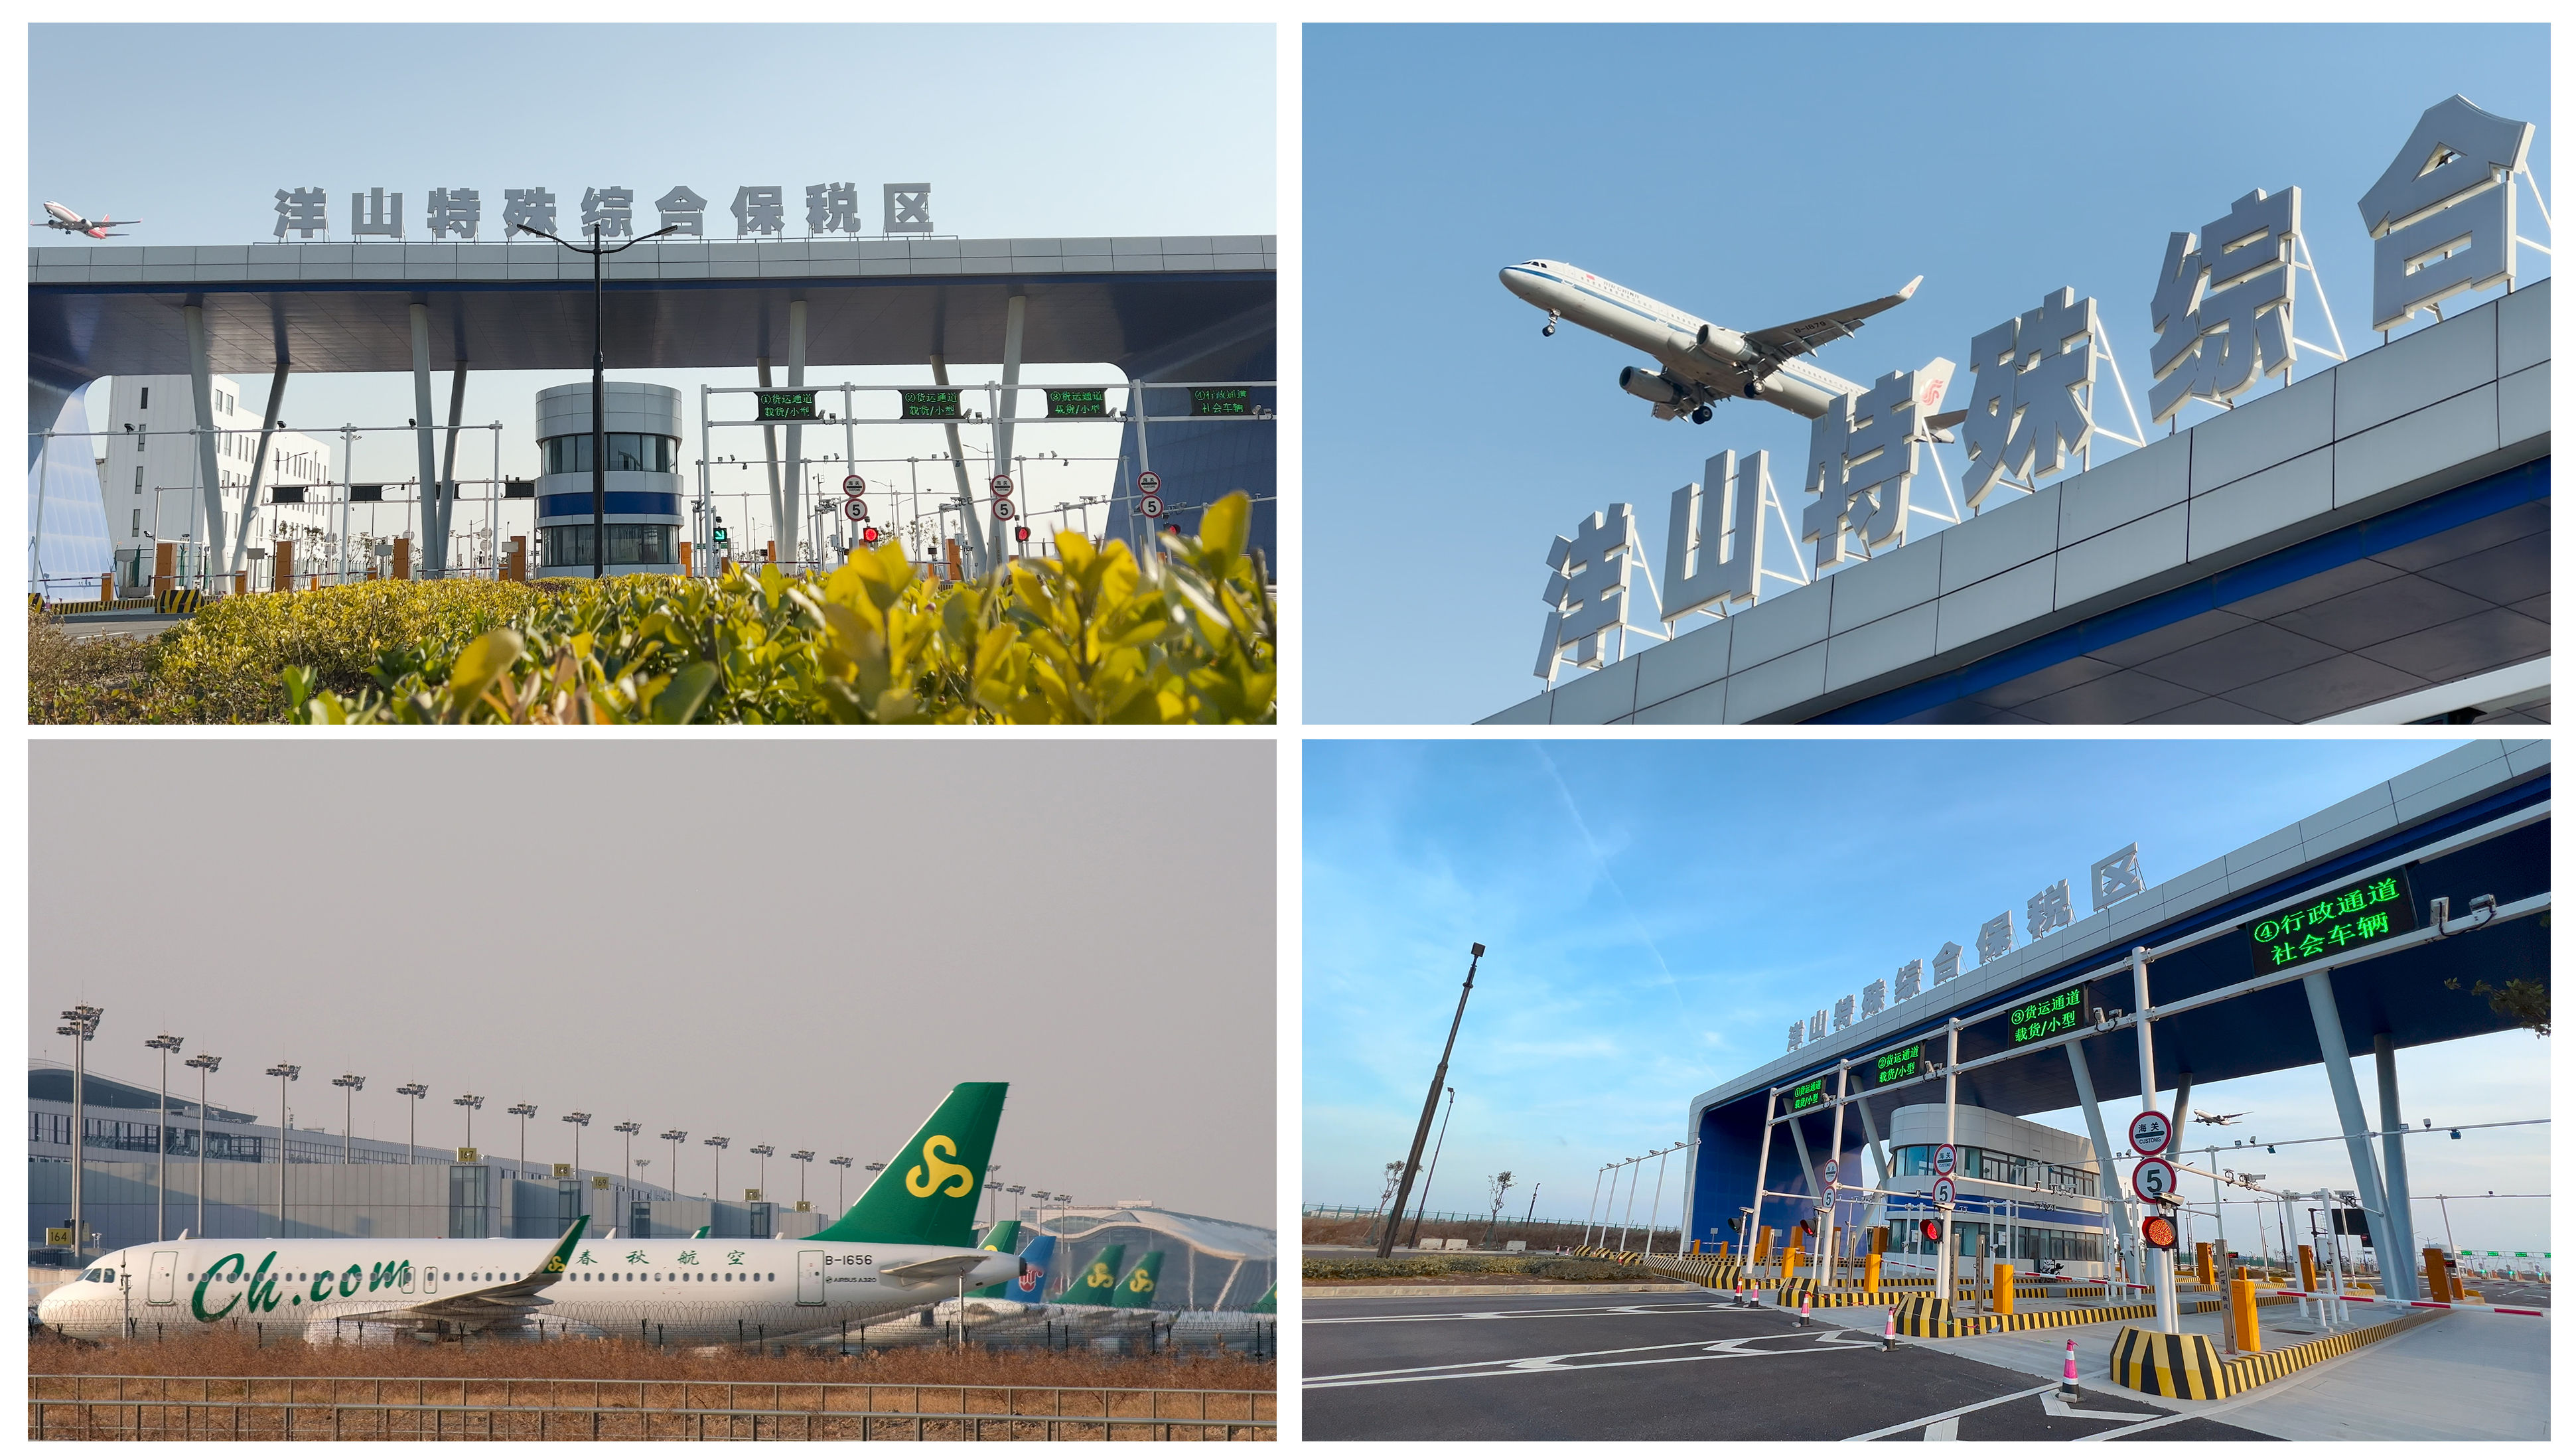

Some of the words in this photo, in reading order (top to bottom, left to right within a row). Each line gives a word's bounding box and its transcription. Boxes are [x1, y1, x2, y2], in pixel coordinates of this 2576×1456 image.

[273, 182, 934, 239] 洋山特殊综合保税区
[1794, 321, 1827, 333] B-1879
[1534, 94, 2535, 682] 洋山特殊综合
[852, 504, 861, 516] 5
[1000, 504, 1009, 516] 5
[1148, 501, 1157, 512] 5
[2254, 878, 2400, 942] ④行政通道
[1787, 841, 2143, 1052] 洋山特殊综合保税区
[2271, 912, 2389, 965] 社会车辆
[2011, 989, 2081, 1025] ③货运通道
[2015, 1011, 2076, 1042] 载货/小型
[1878, 1045, 1919, 1069] ②货运通道
[1879, 1062, 1915, 1083] 载货/小型
[2138, 1122, 2159, 1133] 海关
[2147, 1169, 2162, 1193] 5
[1825, 1193, 1831, 1206] 5
[1940, 1185, 1948, 1202] 5
[50, 1232, 67, 1242] 164
[575, 1250, 745, 1266] 春秋航空
[825, 1255, 873, 1266] B-1656
[191, 1250, 409, 1323] Ch.com
